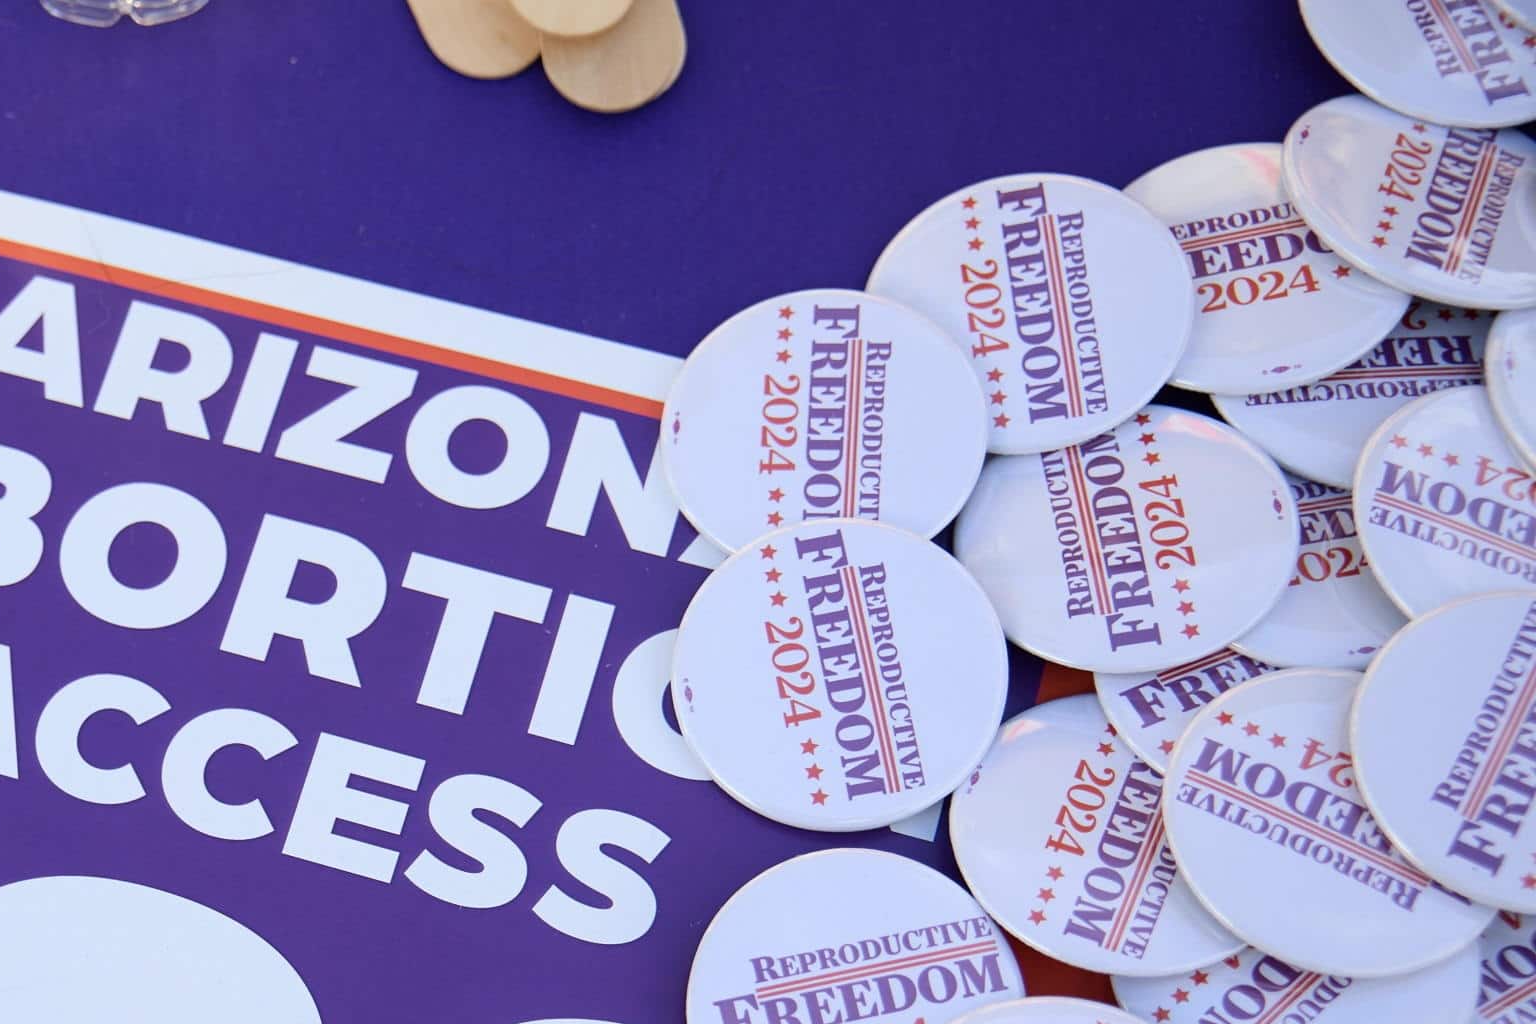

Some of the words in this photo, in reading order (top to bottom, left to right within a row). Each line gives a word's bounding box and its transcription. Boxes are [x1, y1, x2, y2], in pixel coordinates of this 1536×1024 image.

[1378, 133, 1433, 202] 2024
[1169, 202, 1300, 240] EPRODU
[960, 259, 1009, 358] 2024
[996, 182, 1068, 424] FREEDOM
[1057, 210, 1108, 415] REPRODUCTIVE
[1197, 264, 1320, 313] 2024
[759, 374, 800, 474] 2024
[858, 341, 892, 520] REPRODUCTI
[1139, 473, 1197, 570] 2024
[1376, 461, 1536, 548] EDOM
[1475, 455, 1536, 501] 24
[764, 616, 822, 728] 2024
[794, 529, 887, 801] FREEDOM
[858, 562, 926, 790] REPRODUCTIVE
[1045, 759, 1116, 857] 2024
[1298, 736, 1355, 788] 24
[1176, 782, 1423, 913] REPRODUCTIVE
[749, 916, 992, 983] REPRODUCTIVE
